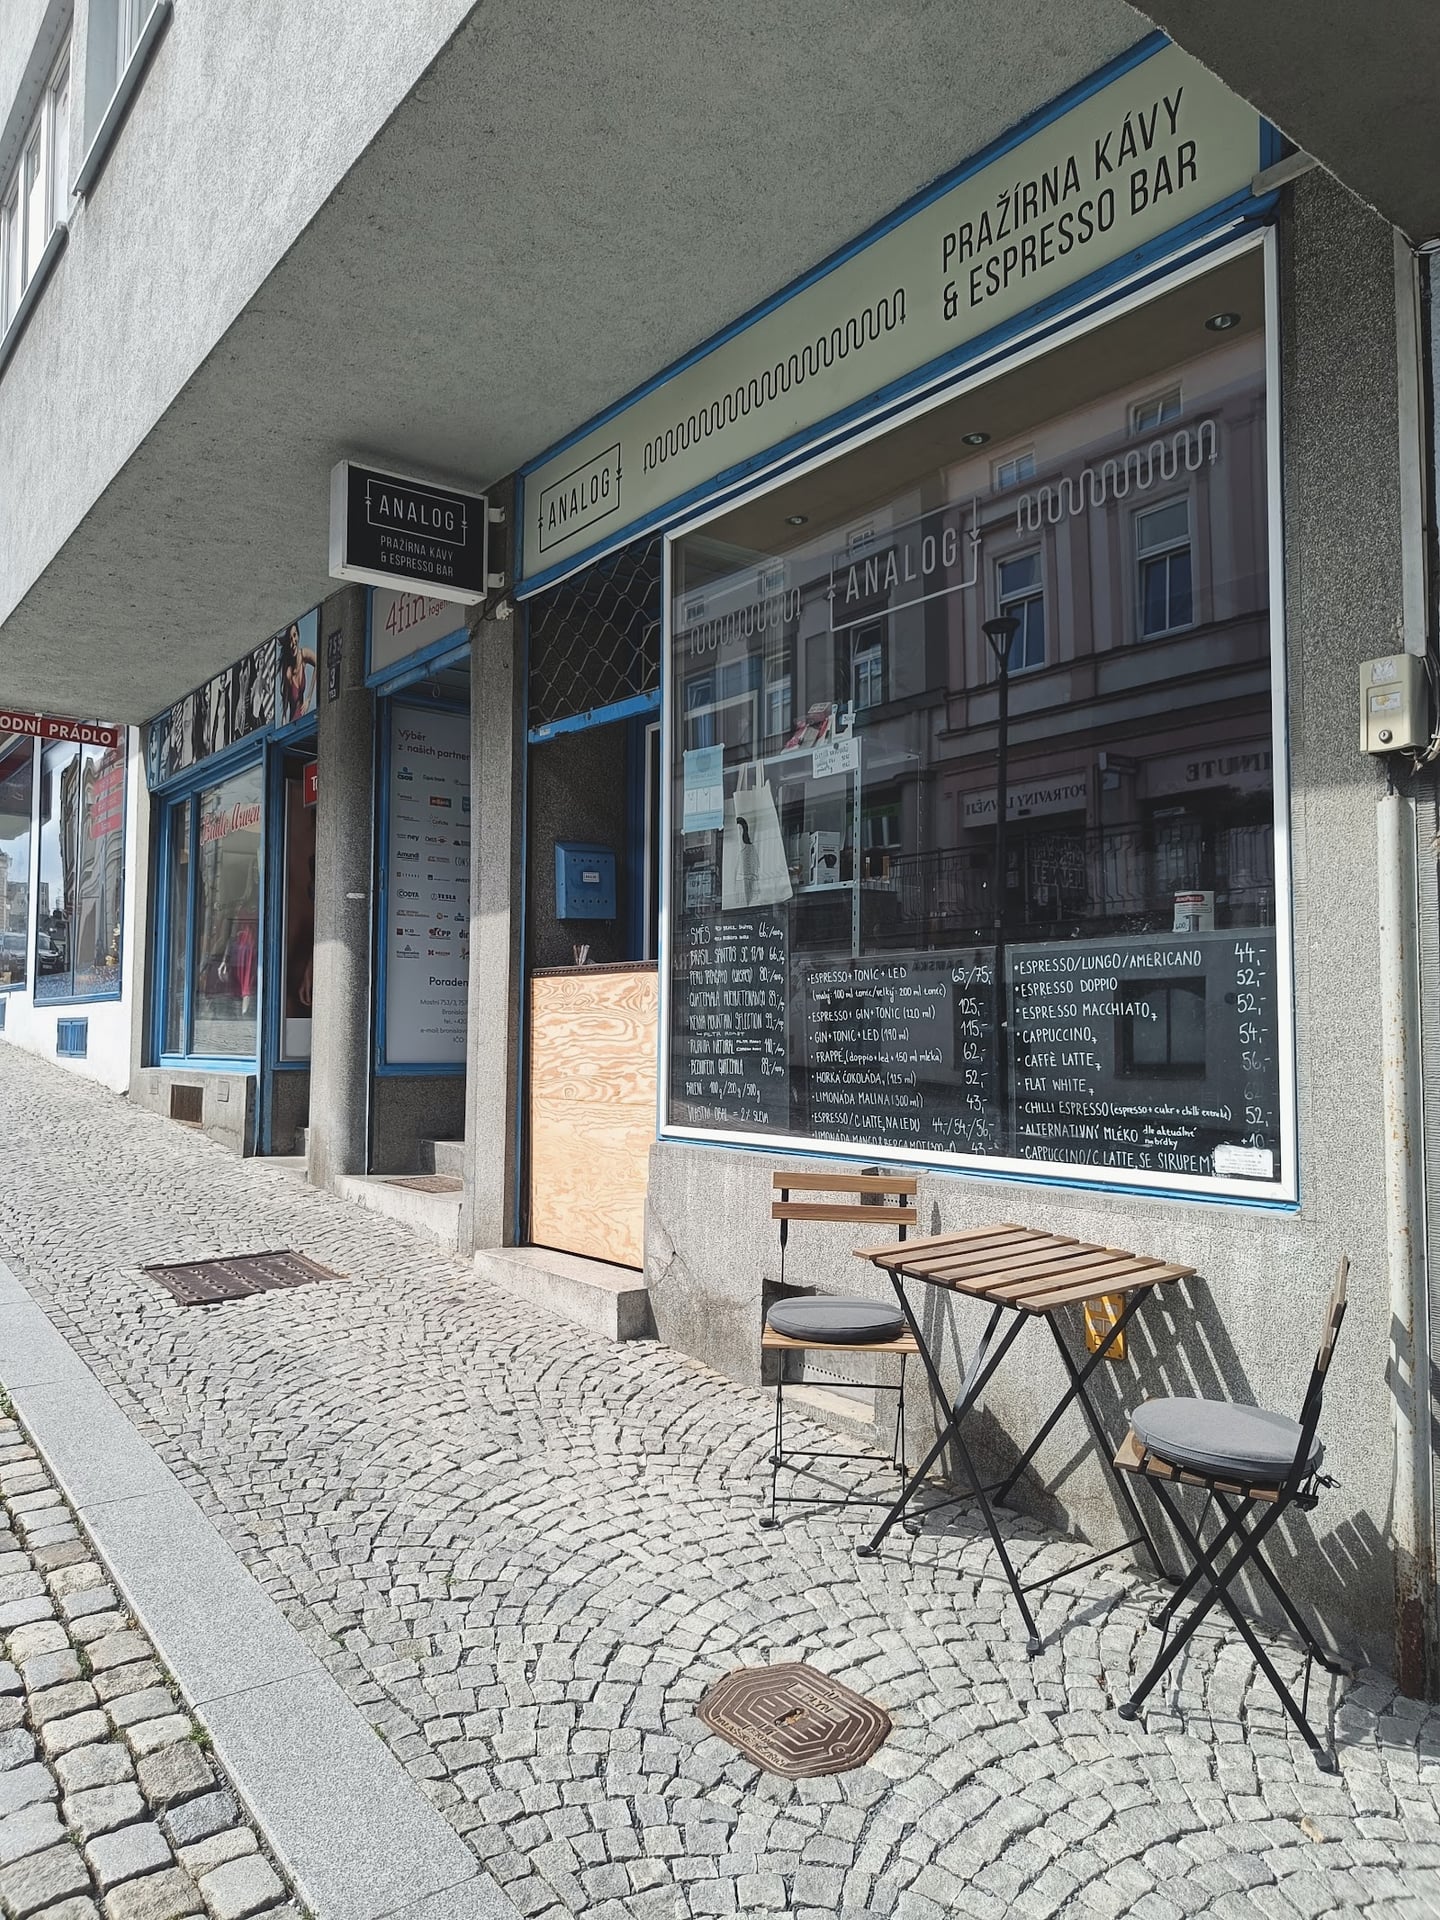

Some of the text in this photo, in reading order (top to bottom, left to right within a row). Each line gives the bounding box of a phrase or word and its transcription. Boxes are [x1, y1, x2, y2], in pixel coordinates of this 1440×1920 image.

[942, 86, 1184, 274] PRAŽÍRNA KÁVY
[943, 140, 1197, 321] & ESPRESSO BAR
[548, 467, 610, 531] ANALOG
[378, 494, 455, 531] ANALOG
[380, 535, 453, 561] PRAŽÍRNA KÁVY
[381, 551, 453, 577] & ESPRESSO BAR
[845, 527, 957, 604] ANALOG
[49, 723, 112, 744] PRÁDLO
[398, 729, 426, 742] Výběr
[407, 743, 435, 757] našich
[691, 924, 711, 945] SMĚS
[1234, 942, 1267, 966] 44,-
[810, 971, 847, 985] ESPRESSO
[853, 968, 879, 982] TONIC
[888, 967, 907, 979] LED
[1021, 968, 1267, 998] ESPRESSO DOPPIO 52,-
[689, 991, 721, 1008] GUATEMALA
[899, 987, 912, 997] 200
[913, 985, 922, 996] ml
[812, 1010, 848, 1023] ESPRESSO
[855, 1008, 870, 1020] GIN
[875, 1007, 900, 1020] TONIC
[922, 1004, 936, 1020] ml)
[958, 997, 985, 1016] 125,-
[1022, 993, 1267, 1020] ESPRESSO MACCHIATO 52,-
[814, 1031, 828, 1044] GIN
[832, 1029, 856, 1043] TONIC
[862, 1028, 879, 1041] LED
[960, 1020, 988, 1038] 115,-
[1022, 1022, 1269, 1044] CAPPUCCINO 54,-
[878, 1051, 889, 1063] led
[909, 1050, 918, 1062] ml
[963, 1042, 987, 1062] 62,-
[1242, 1051, 1271, 1072] 56,-
[816, 1071, 842, 1084] HORKÁ
[965, 1069, 988, 1088] 52,-
[1025, 1077, 1086, 1092] FLAT WHITE
[815, 1090, 856, 1105] LIMONÁDA
[858, 1091, 890, 1106] MALINA
[966, 1094, 988, 1114] 43,-
[886, 1117, 898, 1131] NA
[900, 1117, 921, 1132] LEDU
[1025, 1102, 1055, 1114] CHILLI
[1059, 1101, 1109, 1117] ESPRESSO
[1154, 1104, 1176, 1115] cukr
[1245, 1106, 1273, 1127] 52,-
[1025, 1123, 1100, 1140] ALTERNATIVNÍ
[1104, 1125, 1139, 1142] MLÉKO
[1143, 1125, 1155, 1135] dle
[1144, 1138, 1179, 1151] nabídky
[1139, 1152, 1153, 1168] SE
[801, 1692, 834, 1714] PLYN
